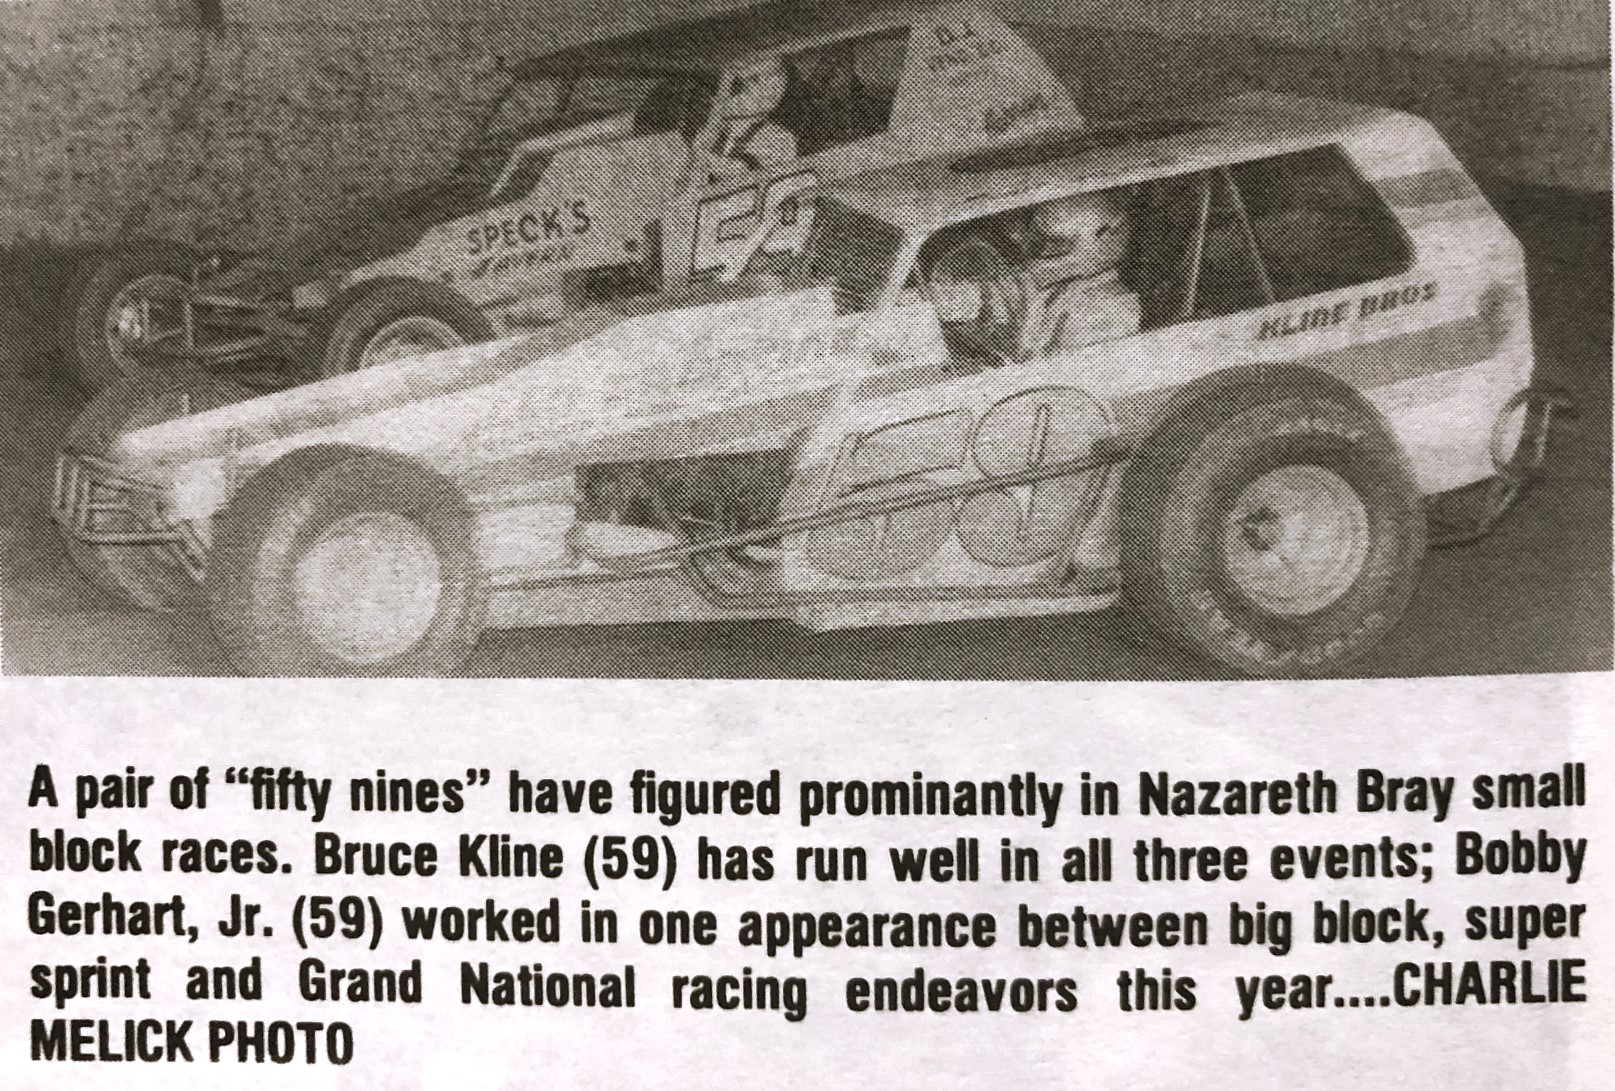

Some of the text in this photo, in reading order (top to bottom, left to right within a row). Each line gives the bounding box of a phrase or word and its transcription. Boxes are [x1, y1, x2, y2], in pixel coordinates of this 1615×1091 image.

[466, 198, 591, 256] SPECK'S
[1257, 301, 1350, 341] KLINE
[28, 763, 1585, 828] A pair of “fifty nines” have figured prominantly in Nazareth Bray small
[31, 829, 1587, 890] block races. Bruce Kline (59) has run well in all three events; Bobby
[28, 891, 1586, 958] Gerhart, Jr. (59) worked in one appearance between big block, super
[31, 956, 1586, 1022] sprint and Grand National racing endeavors this year....CHARLIE
[31, 1019, 353, 1065] MELICK PHOTO
